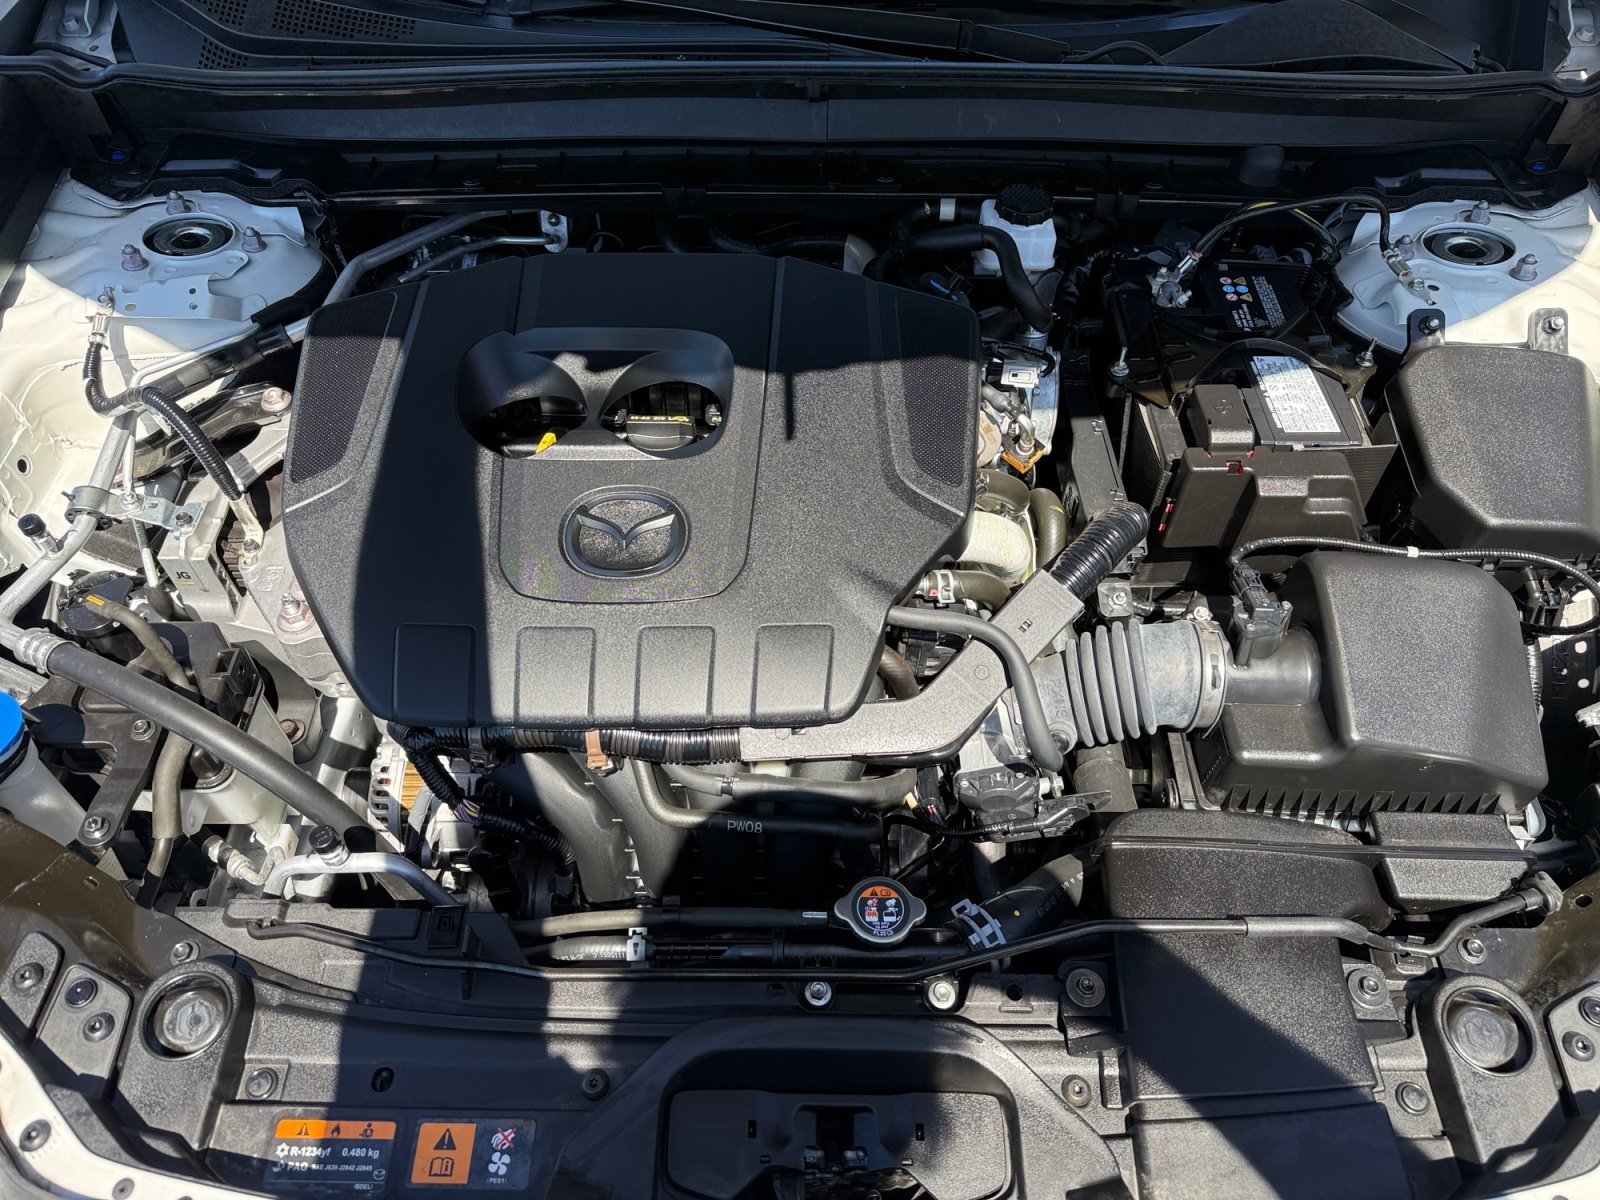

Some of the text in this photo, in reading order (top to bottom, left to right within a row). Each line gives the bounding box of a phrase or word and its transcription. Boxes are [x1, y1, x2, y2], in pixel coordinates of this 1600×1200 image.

[727, 819, 763, 834] PW08
[289, 1146, 380, 1160] R-1234yf 0.480 kg
